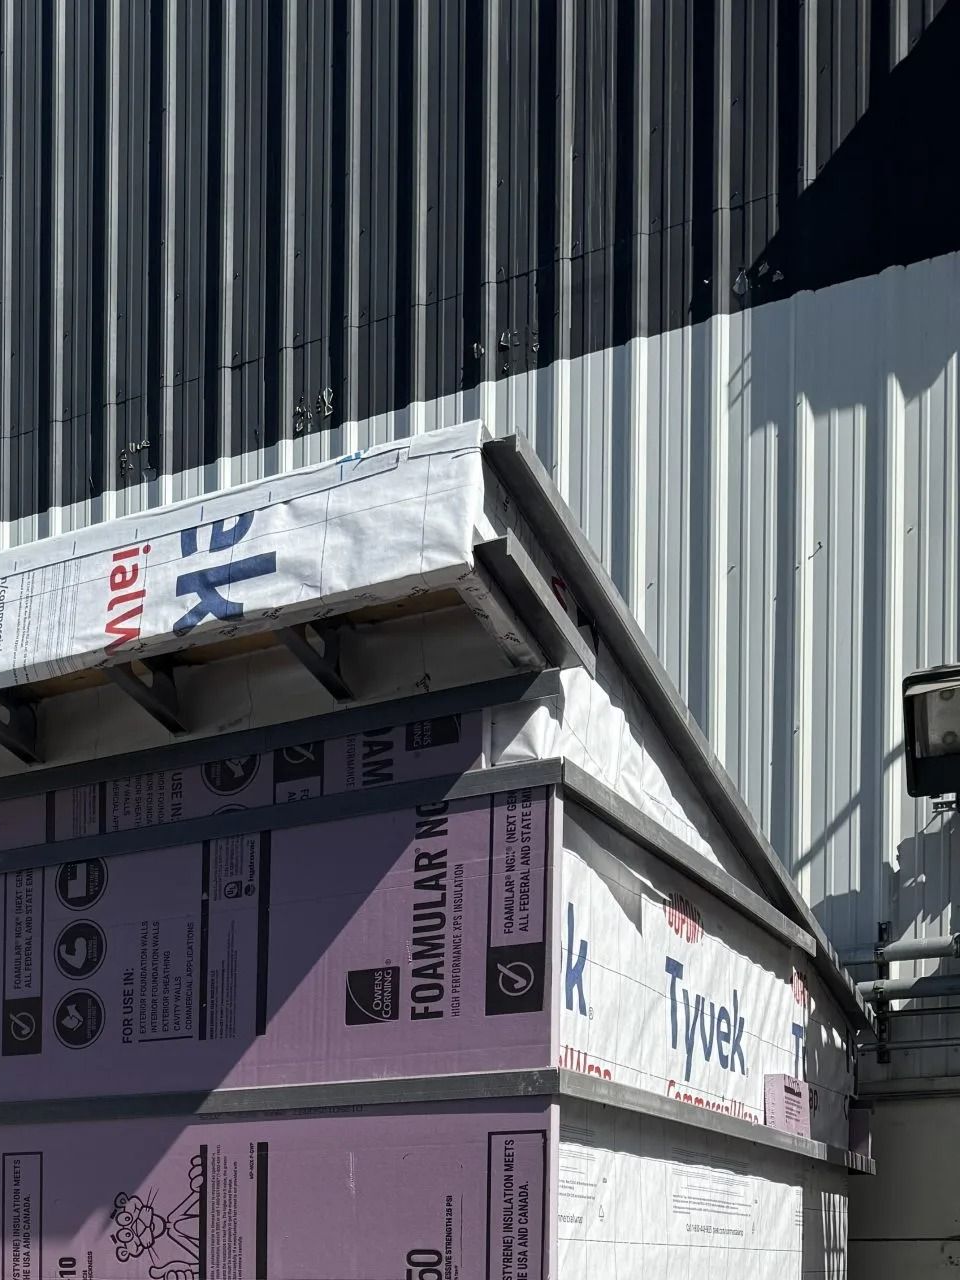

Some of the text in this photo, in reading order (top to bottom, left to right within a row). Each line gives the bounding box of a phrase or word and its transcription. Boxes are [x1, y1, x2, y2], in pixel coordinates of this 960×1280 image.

[505, 815, 518, 843] (NEXT
[518, 811, 532, 932] ALL FEDERAL AND STATE
[24, 886, 33, 988] ALL FEDERAL AND STATE
[141, 920, 149, 947] WALLS
[152, 920, 160, 946] WALLS
[451, 863, 465, 1017] HIGH PERFORMANCE XPS INSULATION
[664, 892, 702, 944] DUPONT
[140, 949, 148, 997] FOUNDATION
[151, 949, 159, 997] FOUNDATION
[162, 950, 171, 1032] EXTERIOR SHEATHING
[373, 971, 382, 1010] OWENS
[382, 969, 393, 1018] CORNING
[121, 968, 135, 1044] FOR USE IN:
[185, 980, 193, 1031] COMMERCIAL
[12, 1159, 21, 1187] MEETS
[504, 1140, 516, 1171] MEETS
[12, 1189, 21, 1237] INSULATION
[22, 1194, 31, 1231] CANADA.
[503, 1175, 515, 1233] INSULATION
[518, 1180, 530, 1225] CANADA.
[22, 1233, 31, 1249] AND
[444, 1218, 453, 1255] STRENGTH
[517, 1227, 529, 1248] AND
[22, 1252, 31, 1268] USA
[517, 1250, 528, 1270] USA
